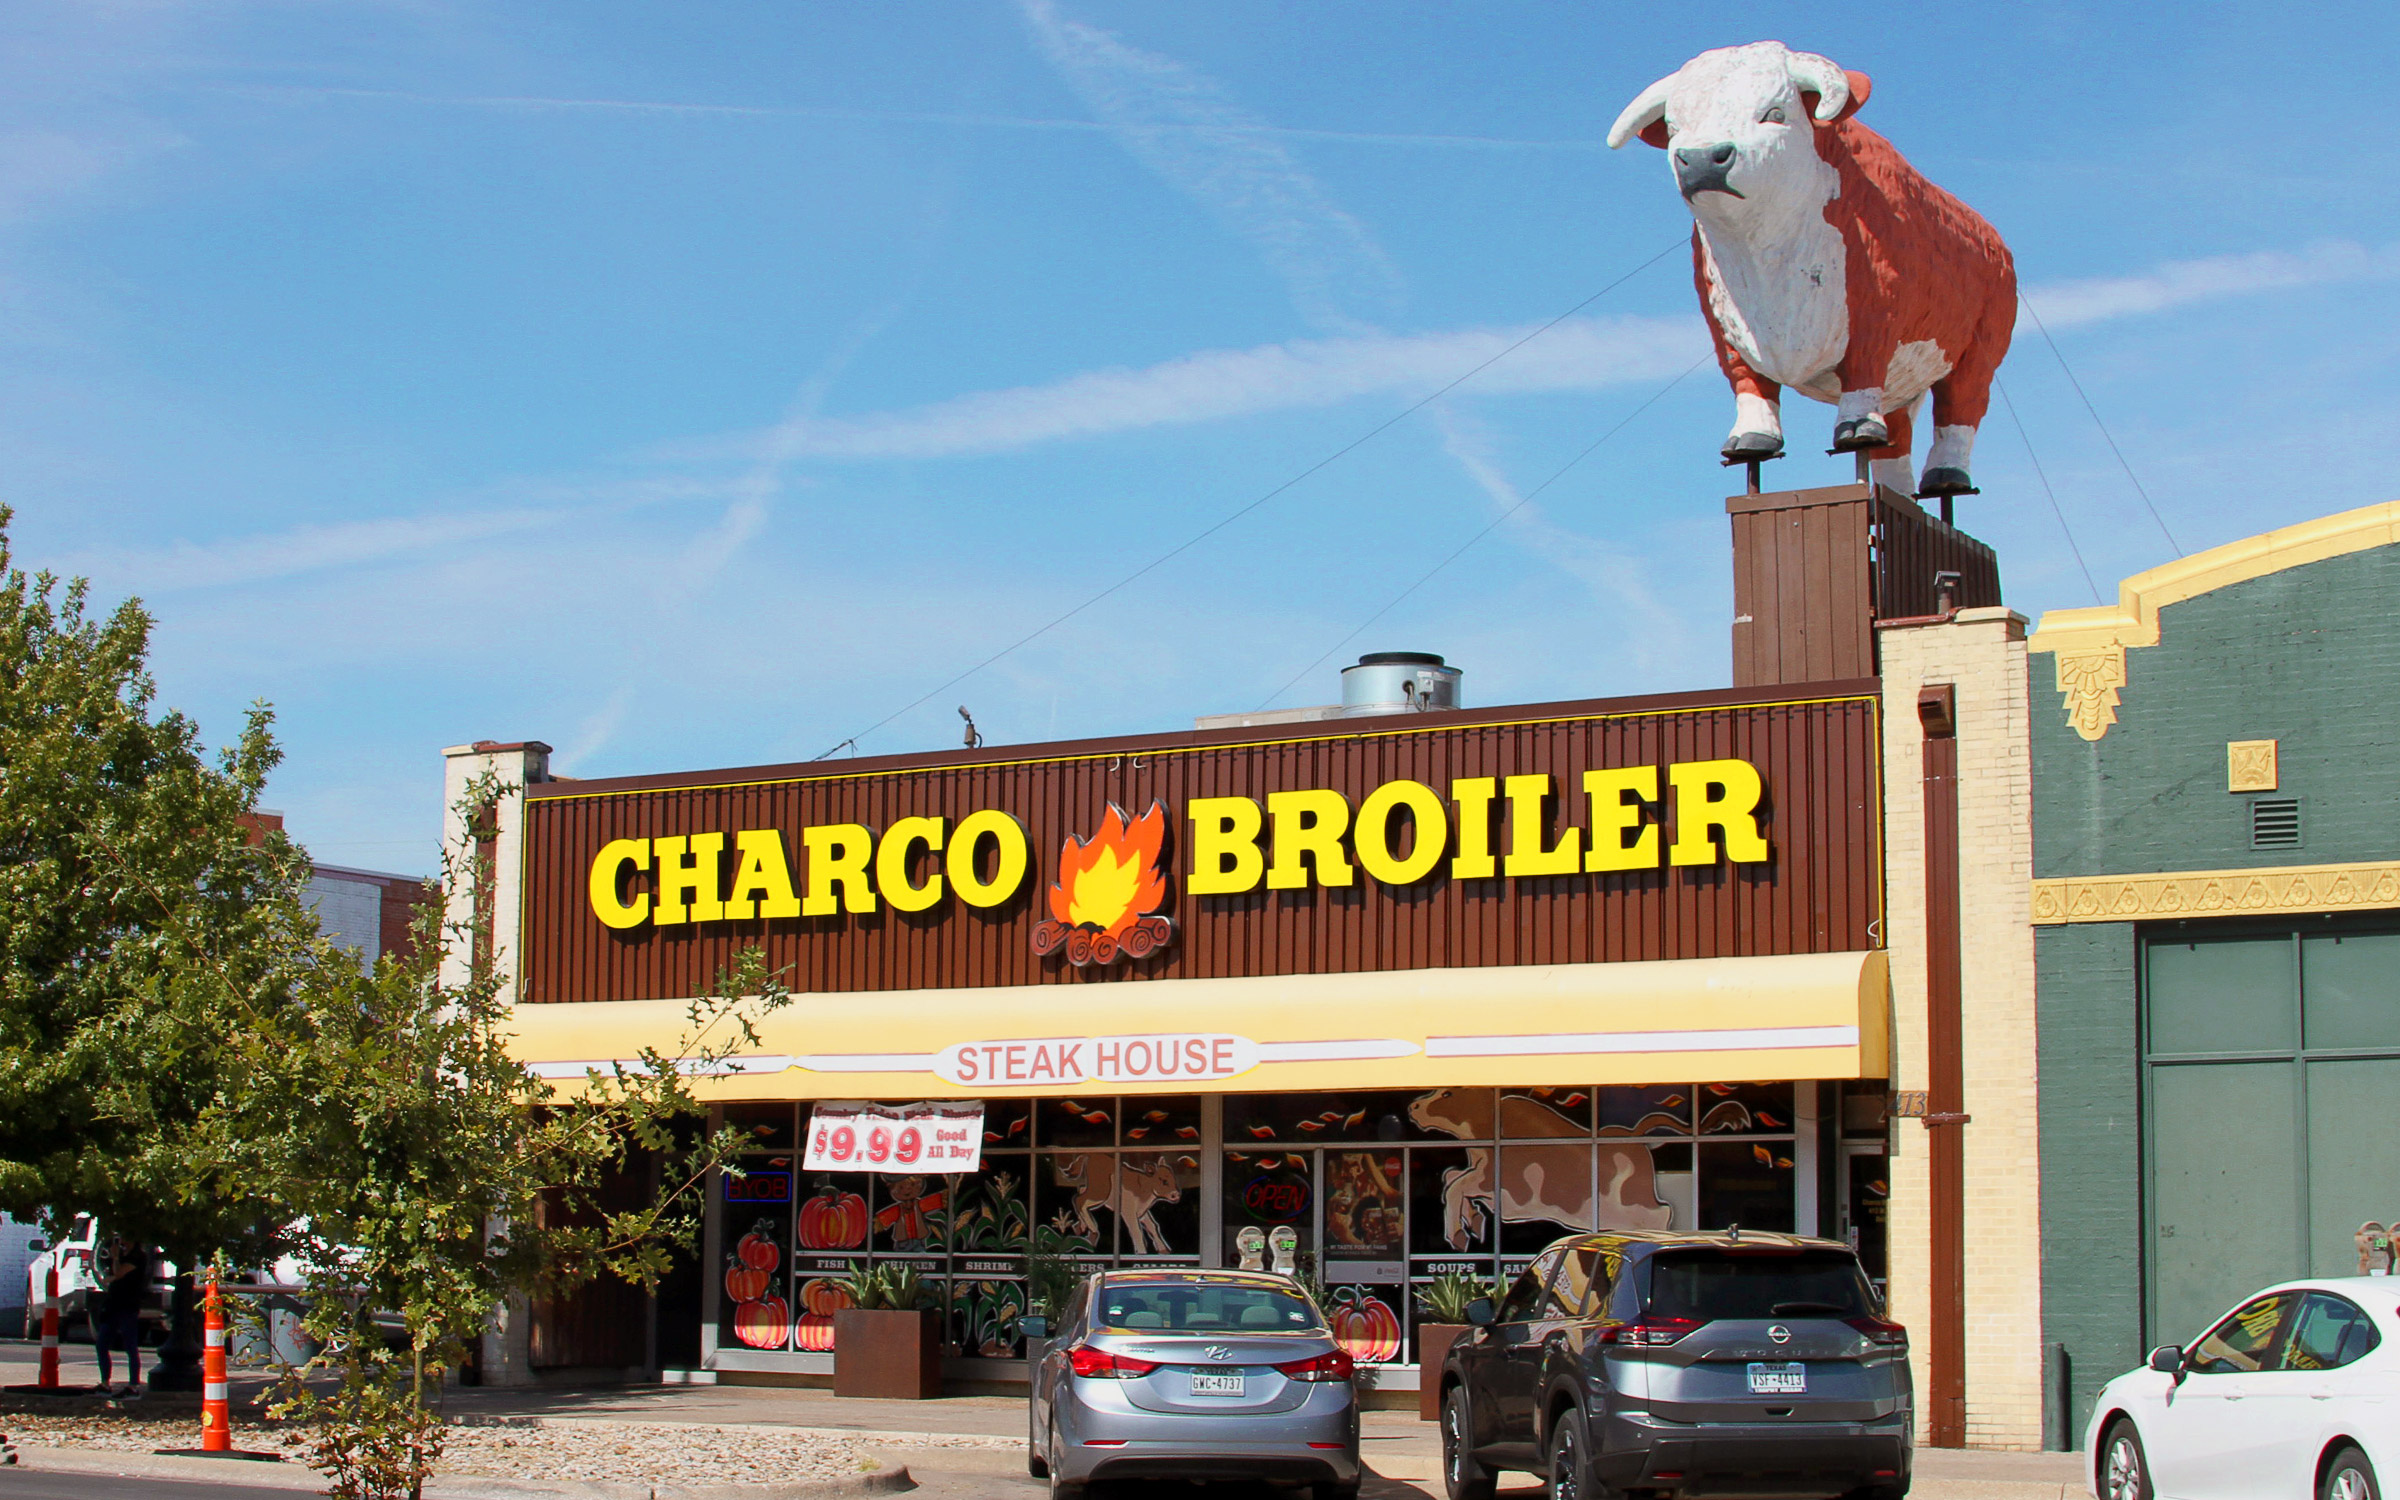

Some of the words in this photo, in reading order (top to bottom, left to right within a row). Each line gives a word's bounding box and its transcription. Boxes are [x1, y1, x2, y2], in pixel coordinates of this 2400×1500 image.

[589, 809, 1029, 929] CHARCO
[1187, 758, 1768, 895] BROILER
[956, 1043, 1084, 1081] STEAK
[1097, 1038, 1235, 1076] HOUSE
[1887, 1091, 1925, 1115] 413
[812, 1124, 923, 1165] $9.99
[936, 1129, 967, 1142] Good
[927, 1146, 944, 1159] All
[950, 1146, 974, 1161] Day
[729, 1178, 788, 1198] BYOB
[1245, 1184, 1307, 1211] OPEN
[816, 1259, 846, 1269] FISH
[1427, 1263, 1476, 1273] SOUPS
